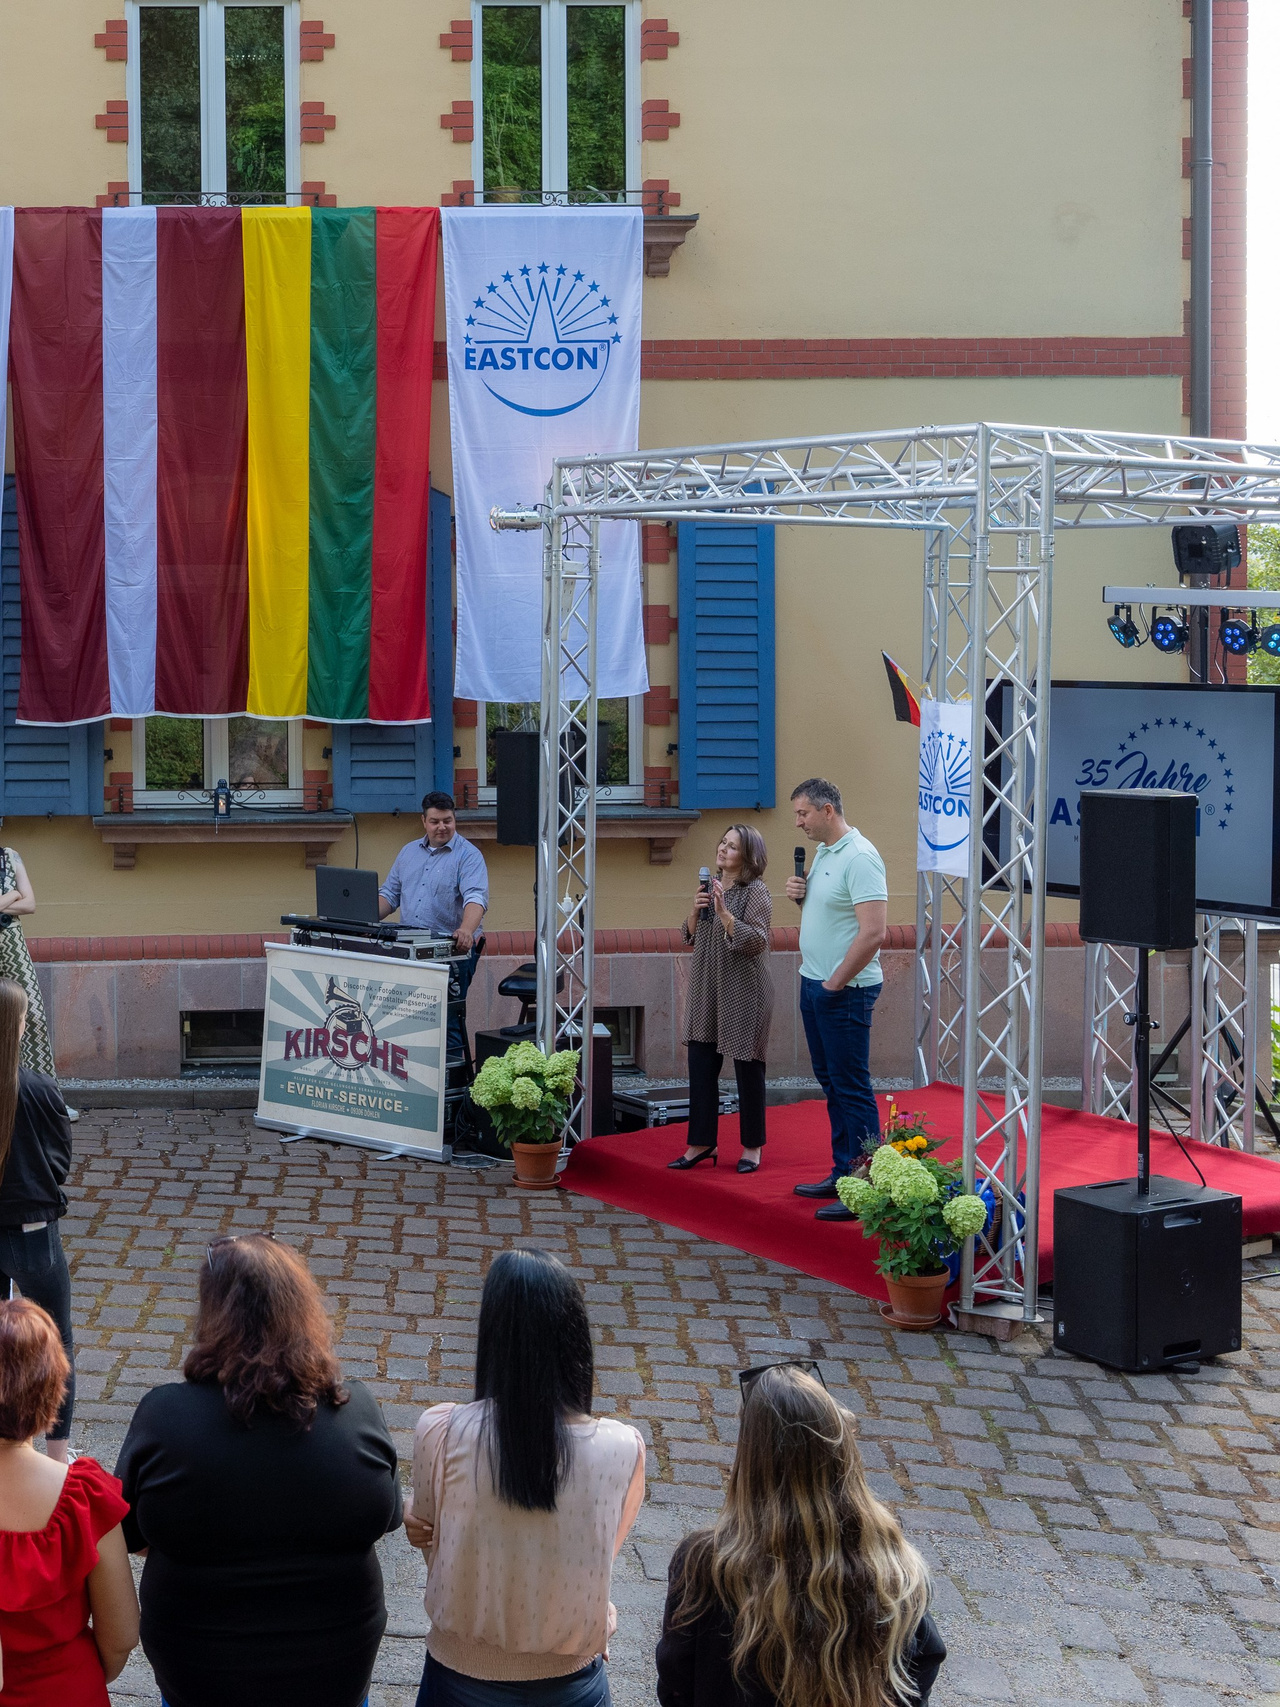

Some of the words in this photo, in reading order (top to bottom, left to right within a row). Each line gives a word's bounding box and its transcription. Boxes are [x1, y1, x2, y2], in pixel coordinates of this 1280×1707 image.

[1075, 758, 1112, 786] 35
[1115, 750, 1211, 793] Jahre
[919, 791, 970, 818] ASTCON
[343, 981, 373, 992] Discothek
[378, 987, 402, 996] Fotobox
[369, 993, 437, 1009] Veranstaltungsservice
[283, 1027, 409, 1083] KIRSCHE
[287, 1081, 403, 1113] EVENT-SERVICE
[311, 1099, 328, 1109] FLORIAN
[328, 1102, 346, 1112] KIRSCHE
